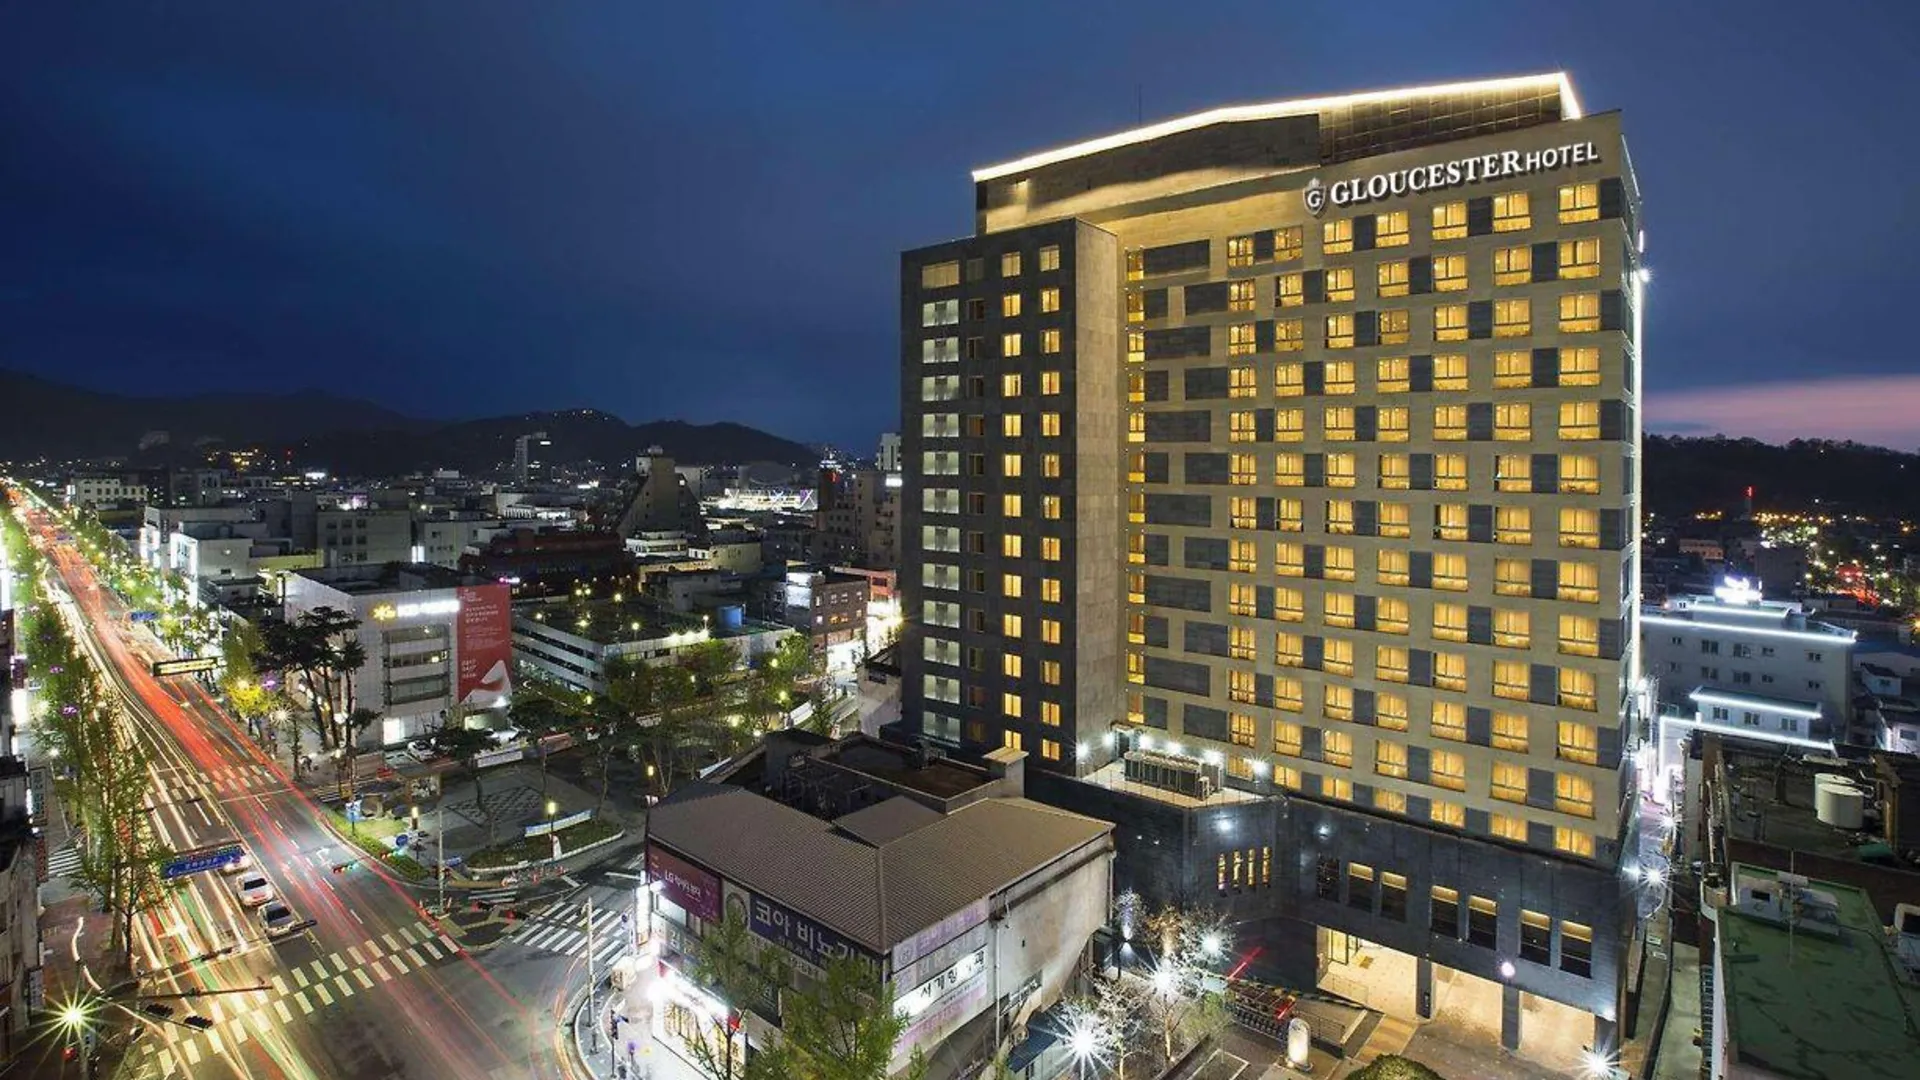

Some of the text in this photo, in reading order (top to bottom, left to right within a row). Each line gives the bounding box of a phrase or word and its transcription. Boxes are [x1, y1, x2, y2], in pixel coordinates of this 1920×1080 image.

[1330, 141, 1599, 205] GLOUCESTER HOTEL
[755, 900, 791, 937] 코아
